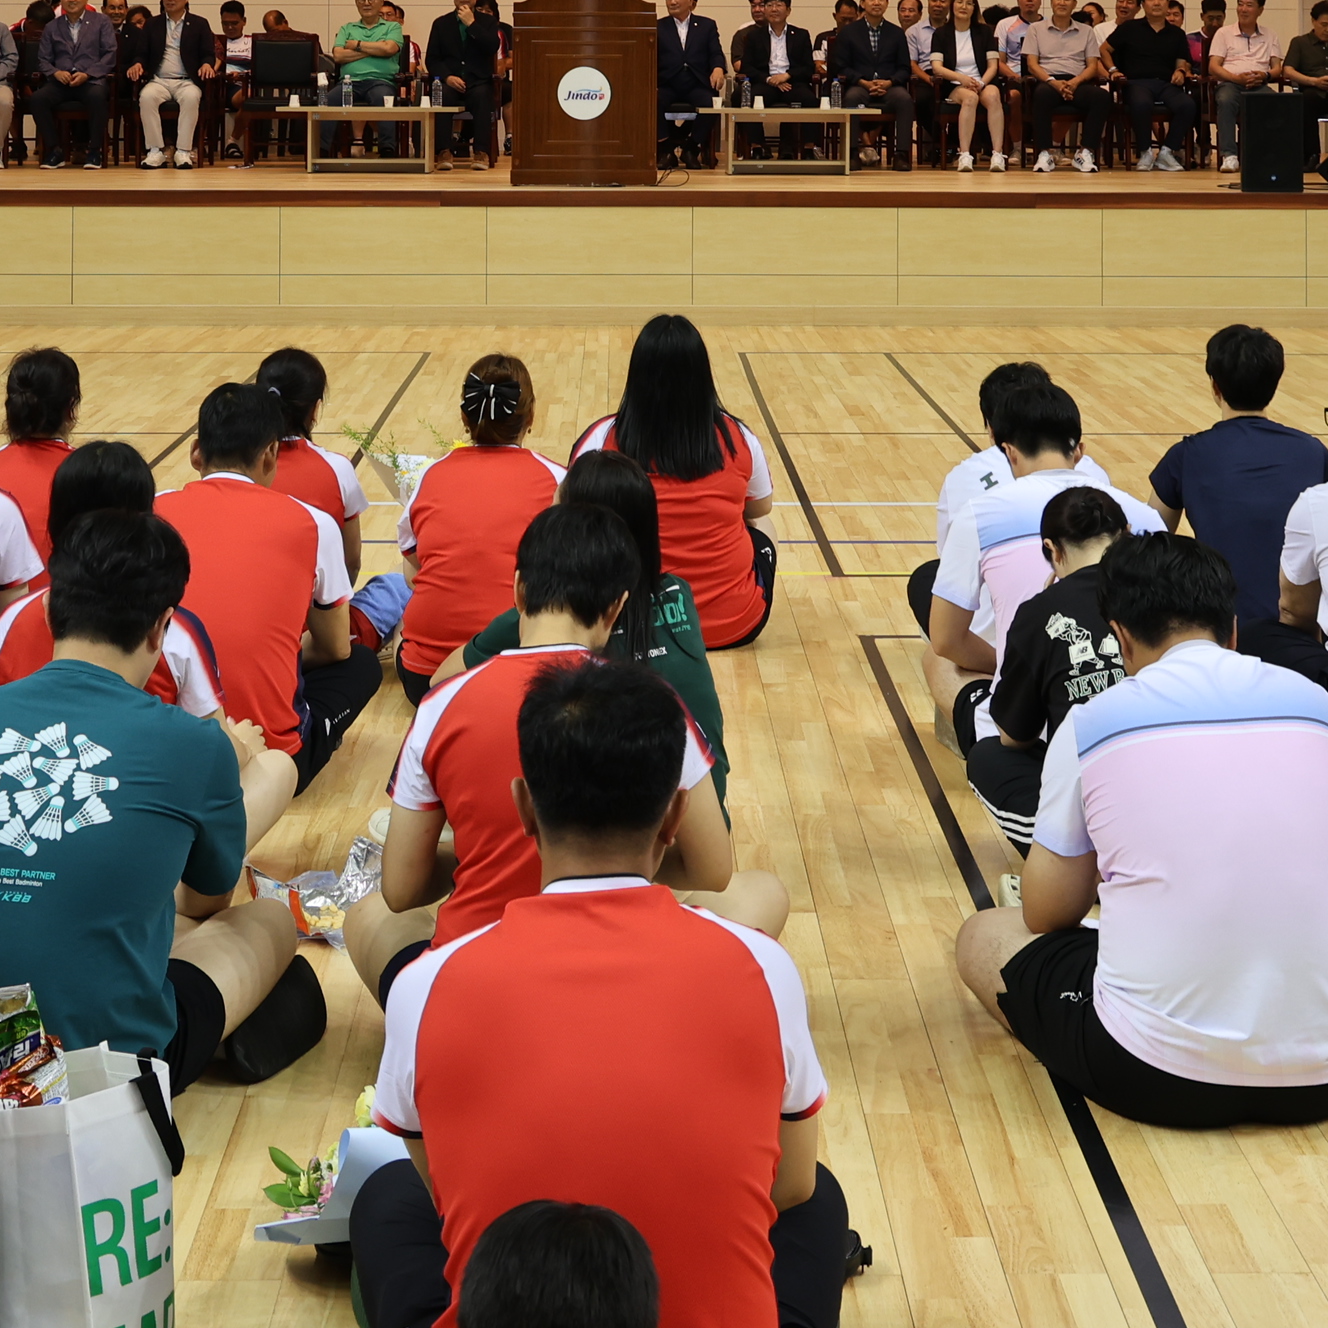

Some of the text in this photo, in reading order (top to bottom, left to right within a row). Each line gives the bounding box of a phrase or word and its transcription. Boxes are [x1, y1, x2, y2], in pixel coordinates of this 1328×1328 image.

[563, 90, 598, 102] Jindo
[1063, 670, 1110, 701] NEW
[0, 868, 20, 877] BEST
[21, 870, 56, 881] PARTNER
[15, 879, 43, 887] Badminton
[81, 1178, 171, 1298] RE:
